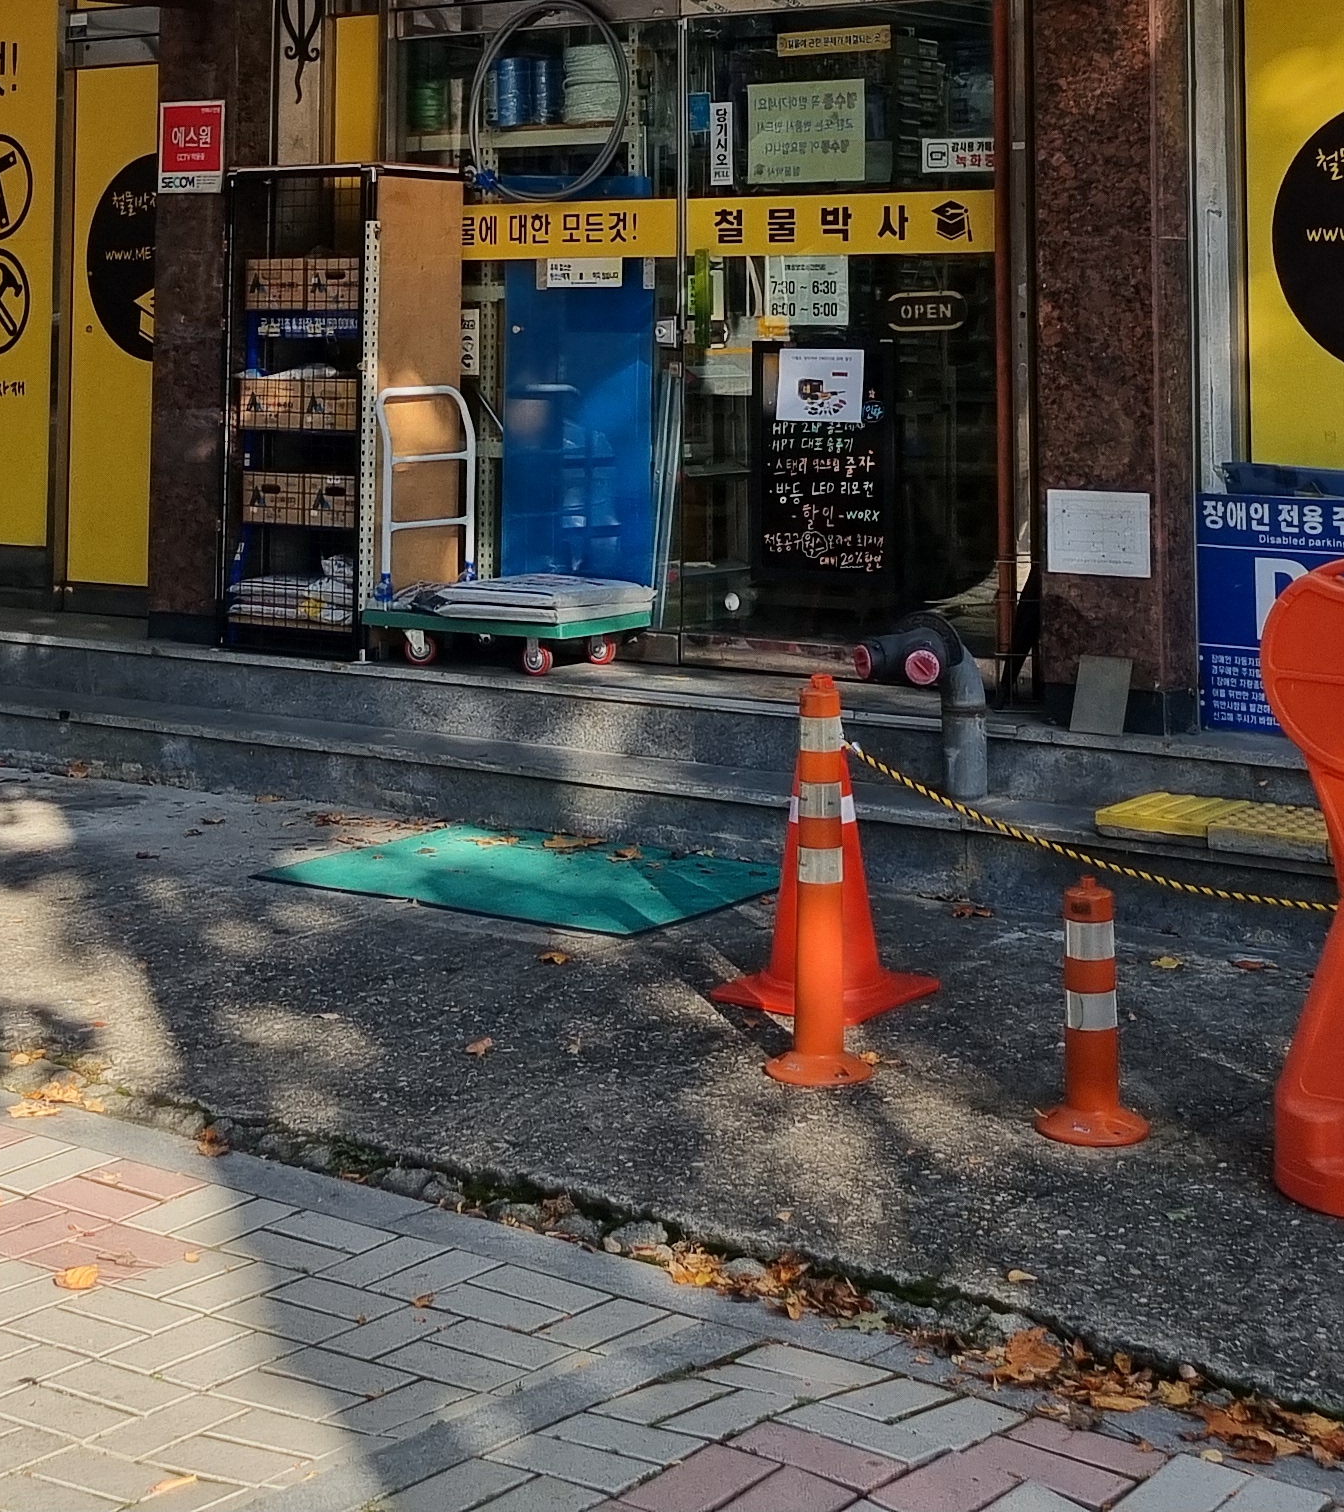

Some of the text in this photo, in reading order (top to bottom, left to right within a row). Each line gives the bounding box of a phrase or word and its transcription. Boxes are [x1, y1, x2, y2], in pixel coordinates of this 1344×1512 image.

[171, 125, 212, 148] 에스원
[716, 108, 728, 166] 당기시오
[977, 141, 994, 152] 카메
[161, 176, 195, 188] SECOM
[461, 210, 639, 246] 물에 대한 모든것!
[812, 280, 837, 295] 6:30
[812, 302, 838, 317] 5:00
[900, 303, 953, 319] OPEN
[811, 481, 835, 496] LED
[1202, 500, 1271, 532] 장애인
[1277, 504, 1324, 535] 전용
[1258, 534, 1306, 547] Disabled
